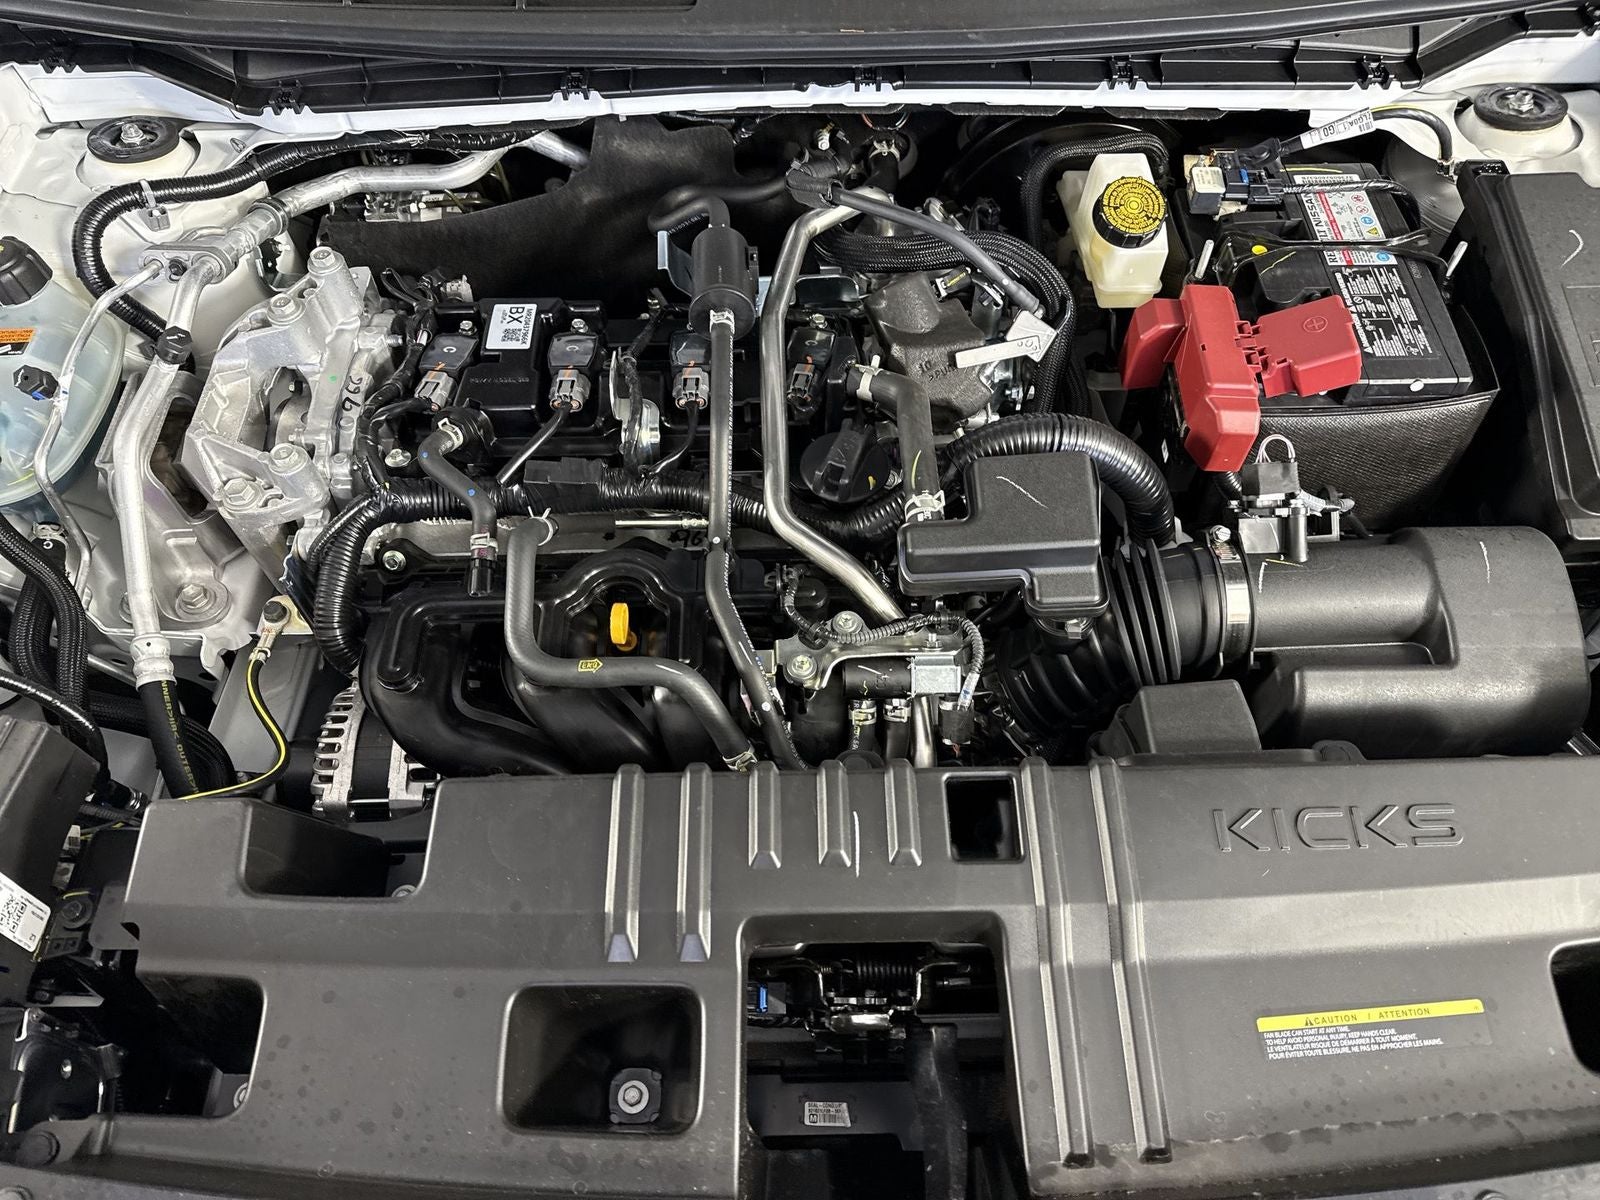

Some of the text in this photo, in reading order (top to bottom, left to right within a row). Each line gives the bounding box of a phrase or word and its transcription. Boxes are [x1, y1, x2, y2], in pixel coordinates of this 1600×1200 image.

[506, 306, 525, 324] BX
[1213, 803, 1464, 852] KICKS
[1314, 1014, 1358, 1025] CAUTION
[1378, 1008, 1431, 1020] ATTENTION
[1287, 1036, 1303, 1044] AVOID
[1303, 1034, 1329, 1042] PERSONAL
